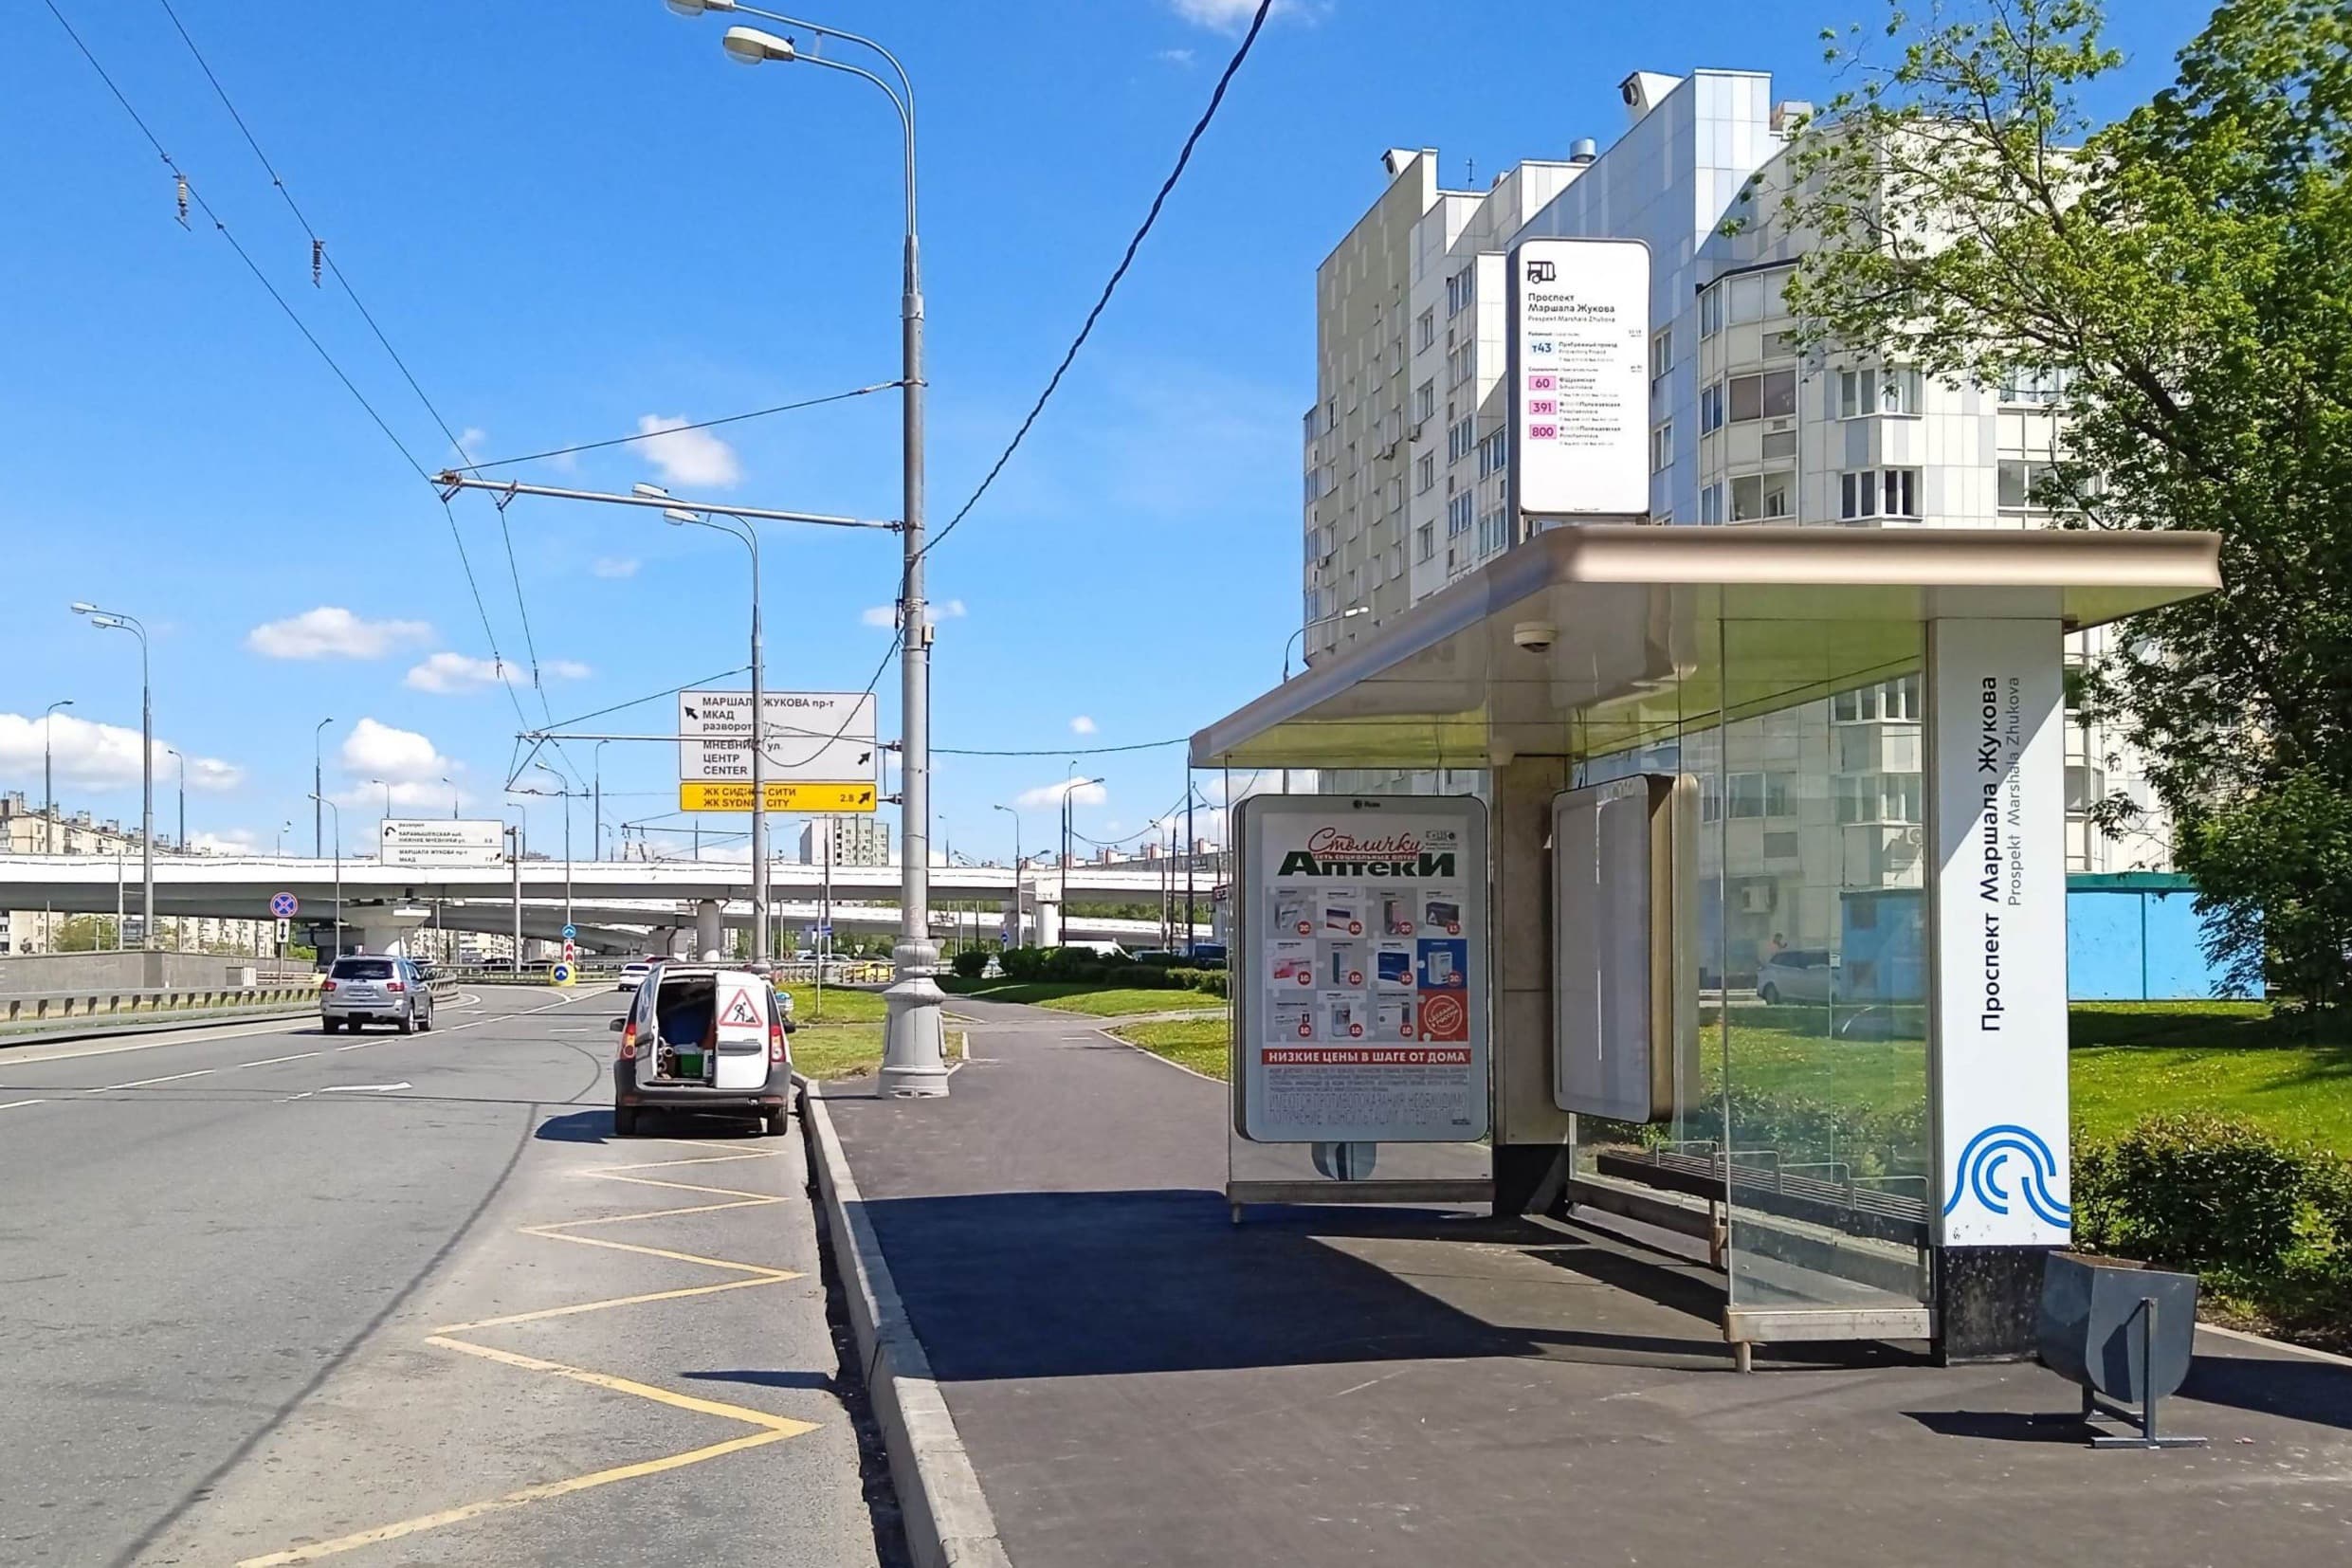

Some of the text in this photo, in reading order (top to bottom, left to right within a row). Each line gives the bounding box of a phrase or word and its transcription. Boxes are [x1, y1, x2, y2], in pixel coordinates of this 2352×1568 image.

[1528, 293, 1575, 302] Проспект
[1527, 303, 1615, 314] Маршала Жукова
[1535, 378, 1550, 388] 60
[1533, 402, 1552, 412] 391
[1532, 427, 1554, 437] 800
[702, 697, 834, 709] МАРШАЛ ЖУКОВА пр-т
[702, 711, 735, 720] МКАД
[702, 723, 752, 732] разворот
[702, 740, 783, 752] МНЕВНИ ул.
[703, 754, 739, 764] ЦЕНТР
[703, 766, 747, 775] CENTER
[703, 788, 720, 796] ЖК
[2006, 676, 2024, 906] Prospekt Marshala Zhukova
[703, 798, 720, 807] ЖК
[767, 799, 790, 808] CITY
[1307, 827, 1425, 852] Столички
[1978, 676, 2004, 1031] Проспект Маршала Жукова
[1268, 1052, 1466, 1064] НИЗКИЕ ЦЕНЫ В ШАГЕ ОТ ДОМА
